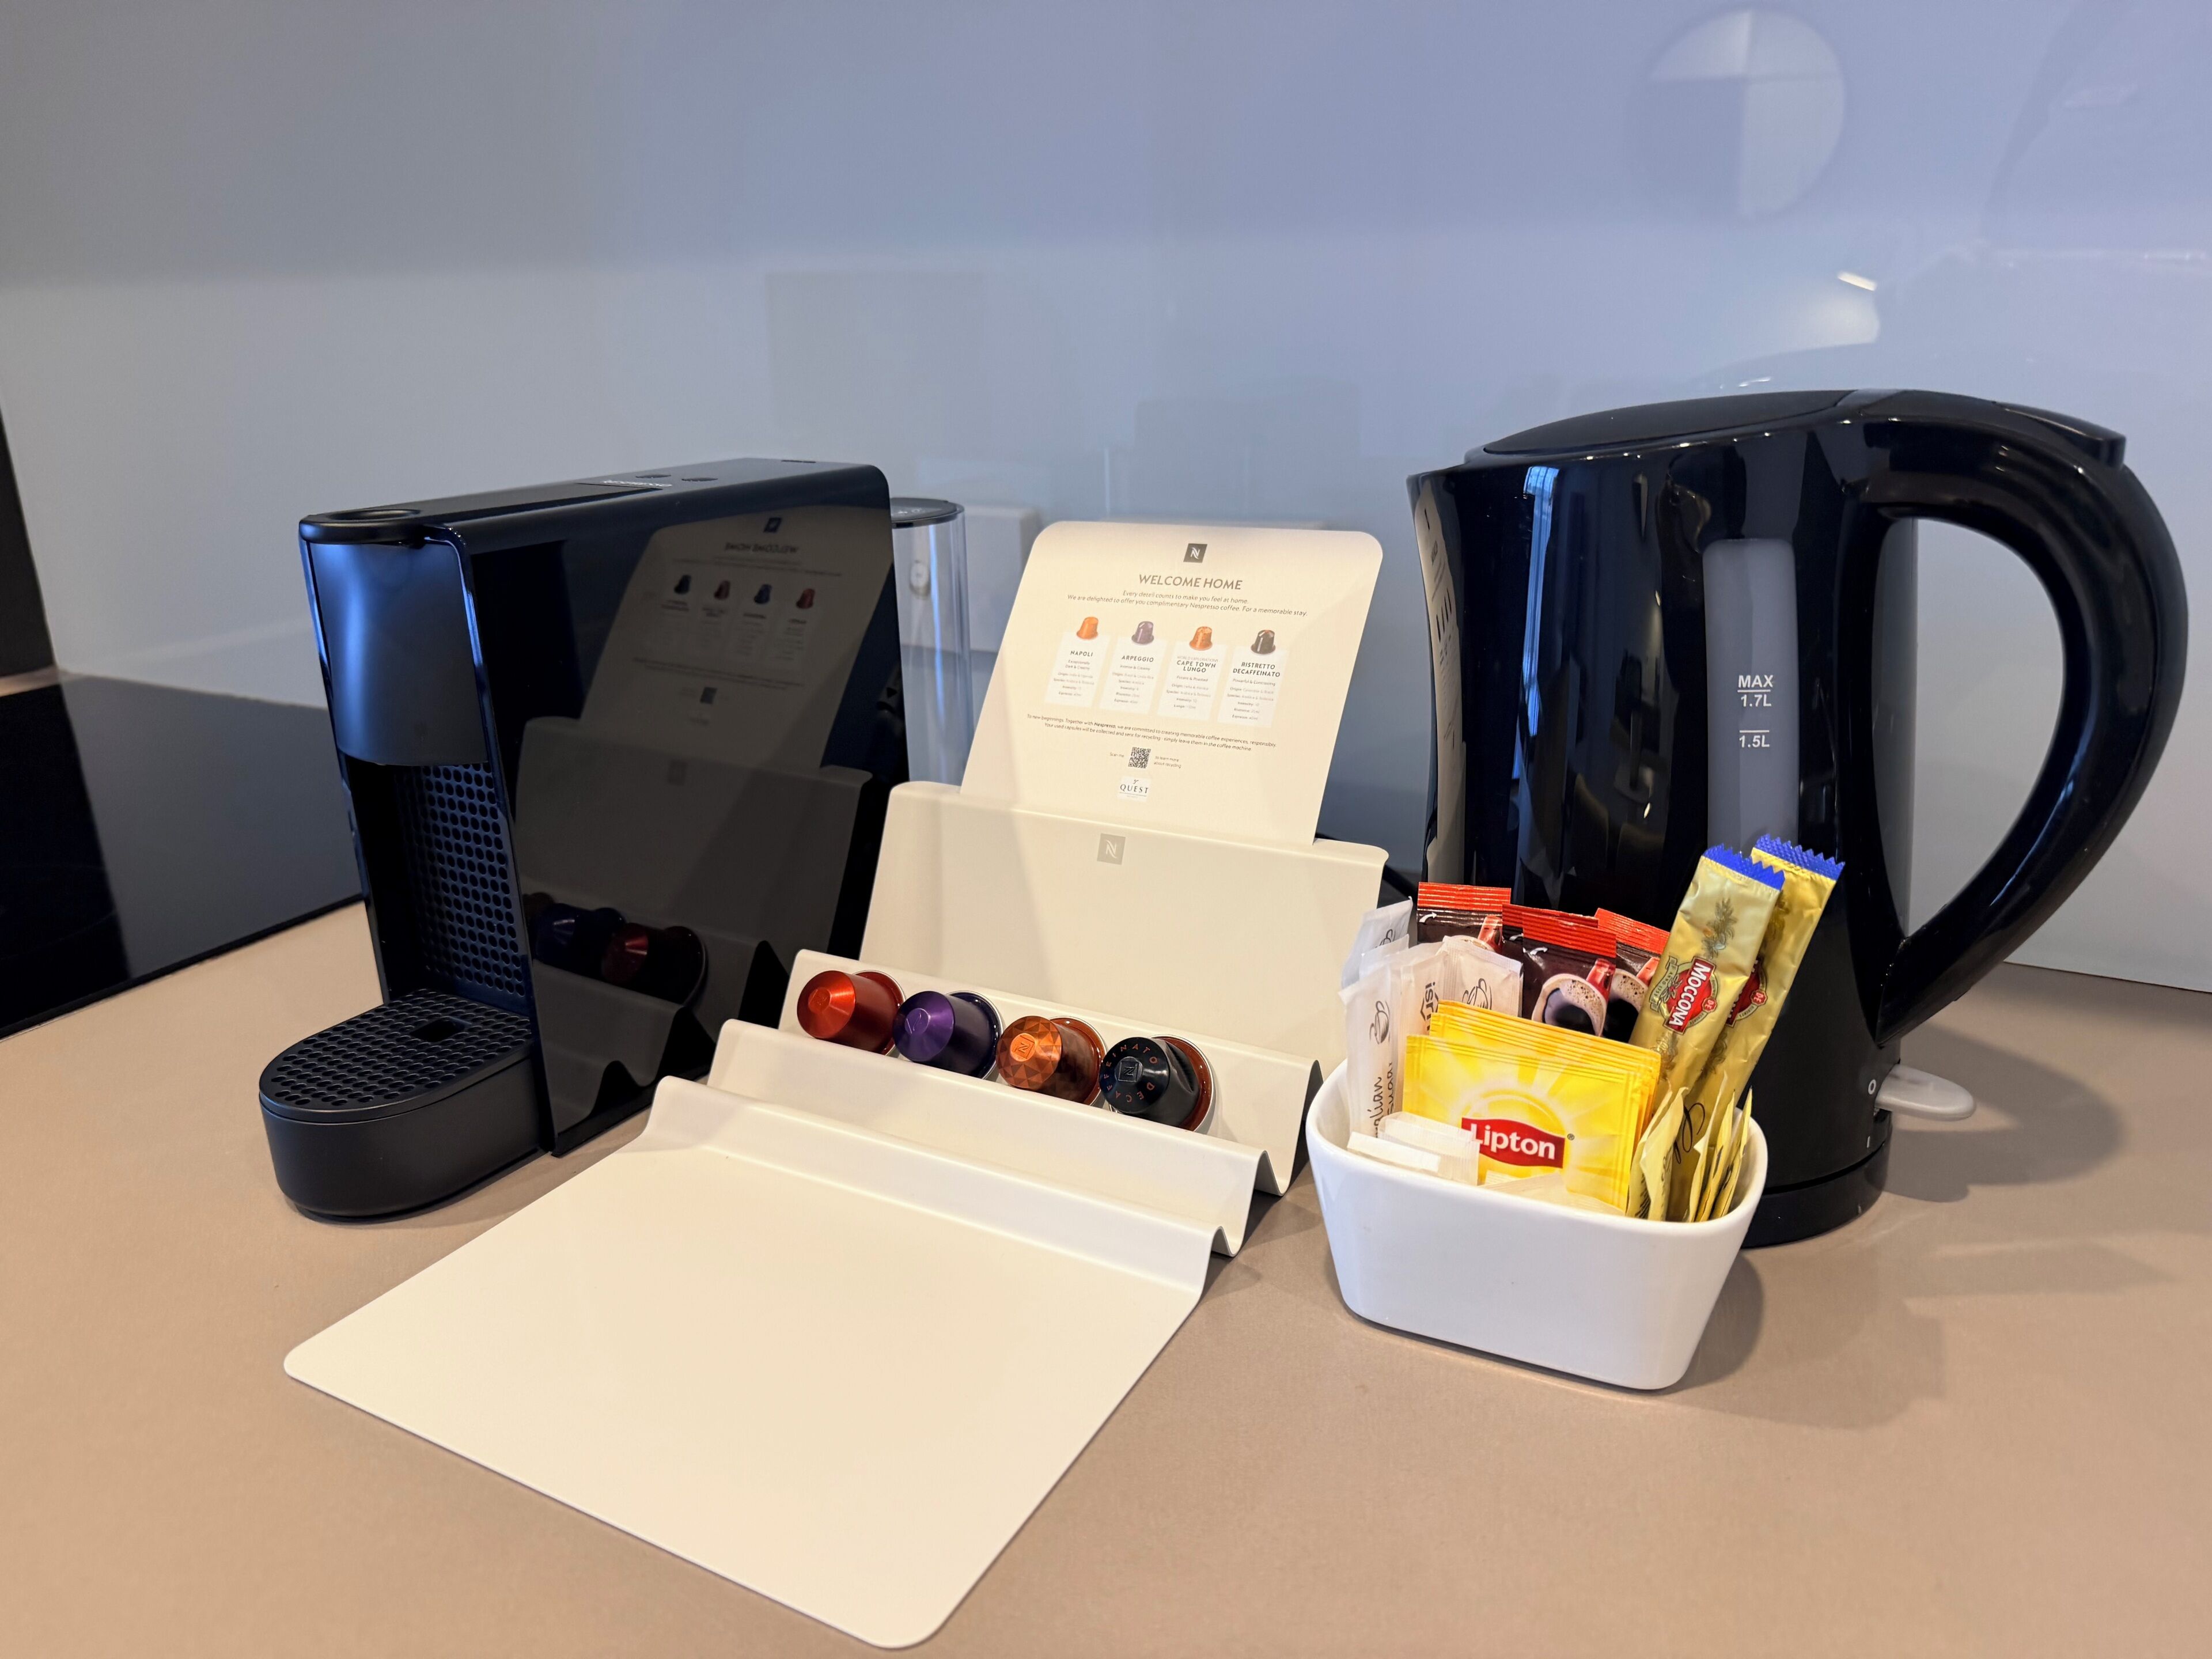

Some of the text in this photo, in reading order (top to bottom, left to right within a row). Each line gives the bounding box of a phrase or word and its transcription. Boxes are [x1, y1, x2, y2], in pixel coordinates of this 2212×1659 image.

[1139, 574, 1243, 590] WELCOME HOME
[1146, 600, 1189, 608] complimentary
[1241, 661, 1275, 670] RISTRETTO
[1233, 668, 1281, 677] DECAFFEINATO
[1738, 675, 1774, 688] MAX
[1741, 694, 1772, 707] 1.7L
[1739, 734, 1770, 748] 1.5L
[1119, 783, 1149, 794] QUEST
[1669, 962, 1711, 1027] MOCCONA
[1753, 992, 1764, 1004] DE
[1704, 999, 1714, 1010] DE
[1103, 1043, 1158, 1103] DECAFFEINATO
[1470, 1123, 1555, 1160] Lipton
